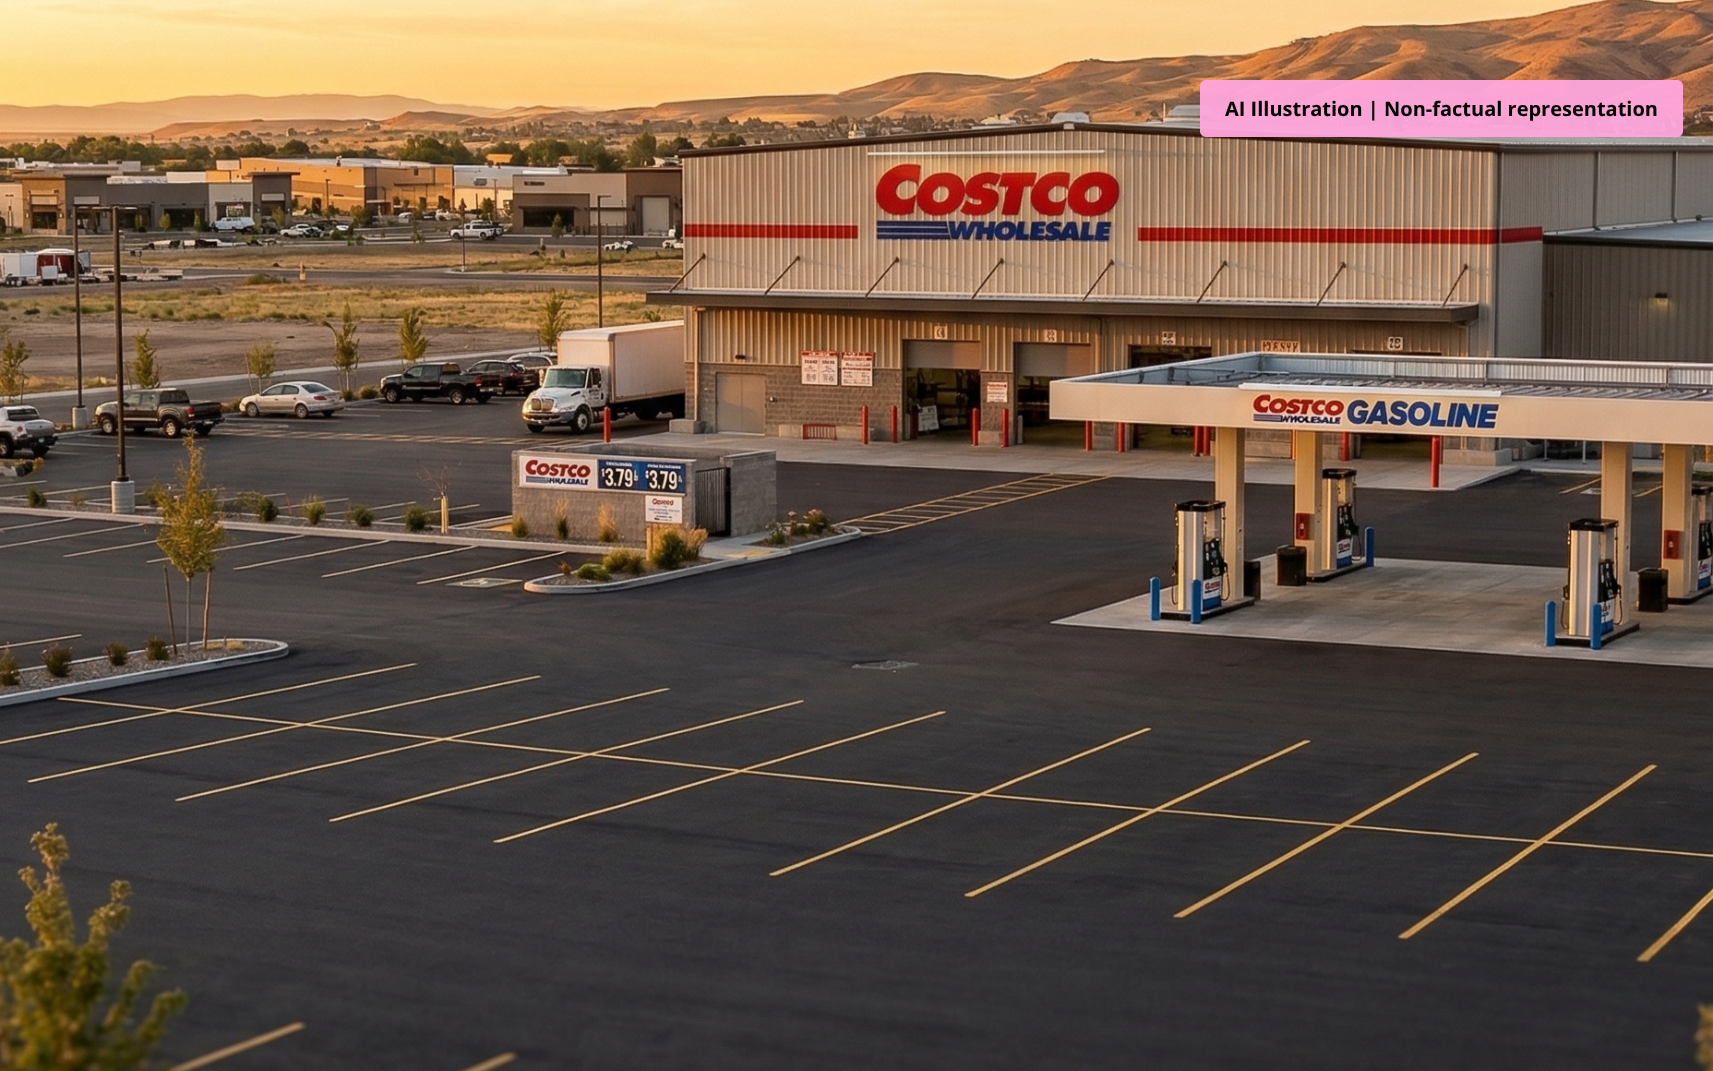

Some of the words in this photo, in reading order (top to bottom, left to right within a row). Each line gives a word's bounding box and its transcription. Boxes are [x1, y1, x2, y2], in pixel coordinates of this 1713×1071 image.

[876, 164, 1120, 216] COSTCO
[949, 220, 1111, 241] WHOLESALE
[1253, 394, 1344, 416] COSTCO
[1347, 399, 1499, 429] GASOLINE
[1281, 414, 1341, 425] WHOLESALE
[525, 459, 591, 478] COSTCO
